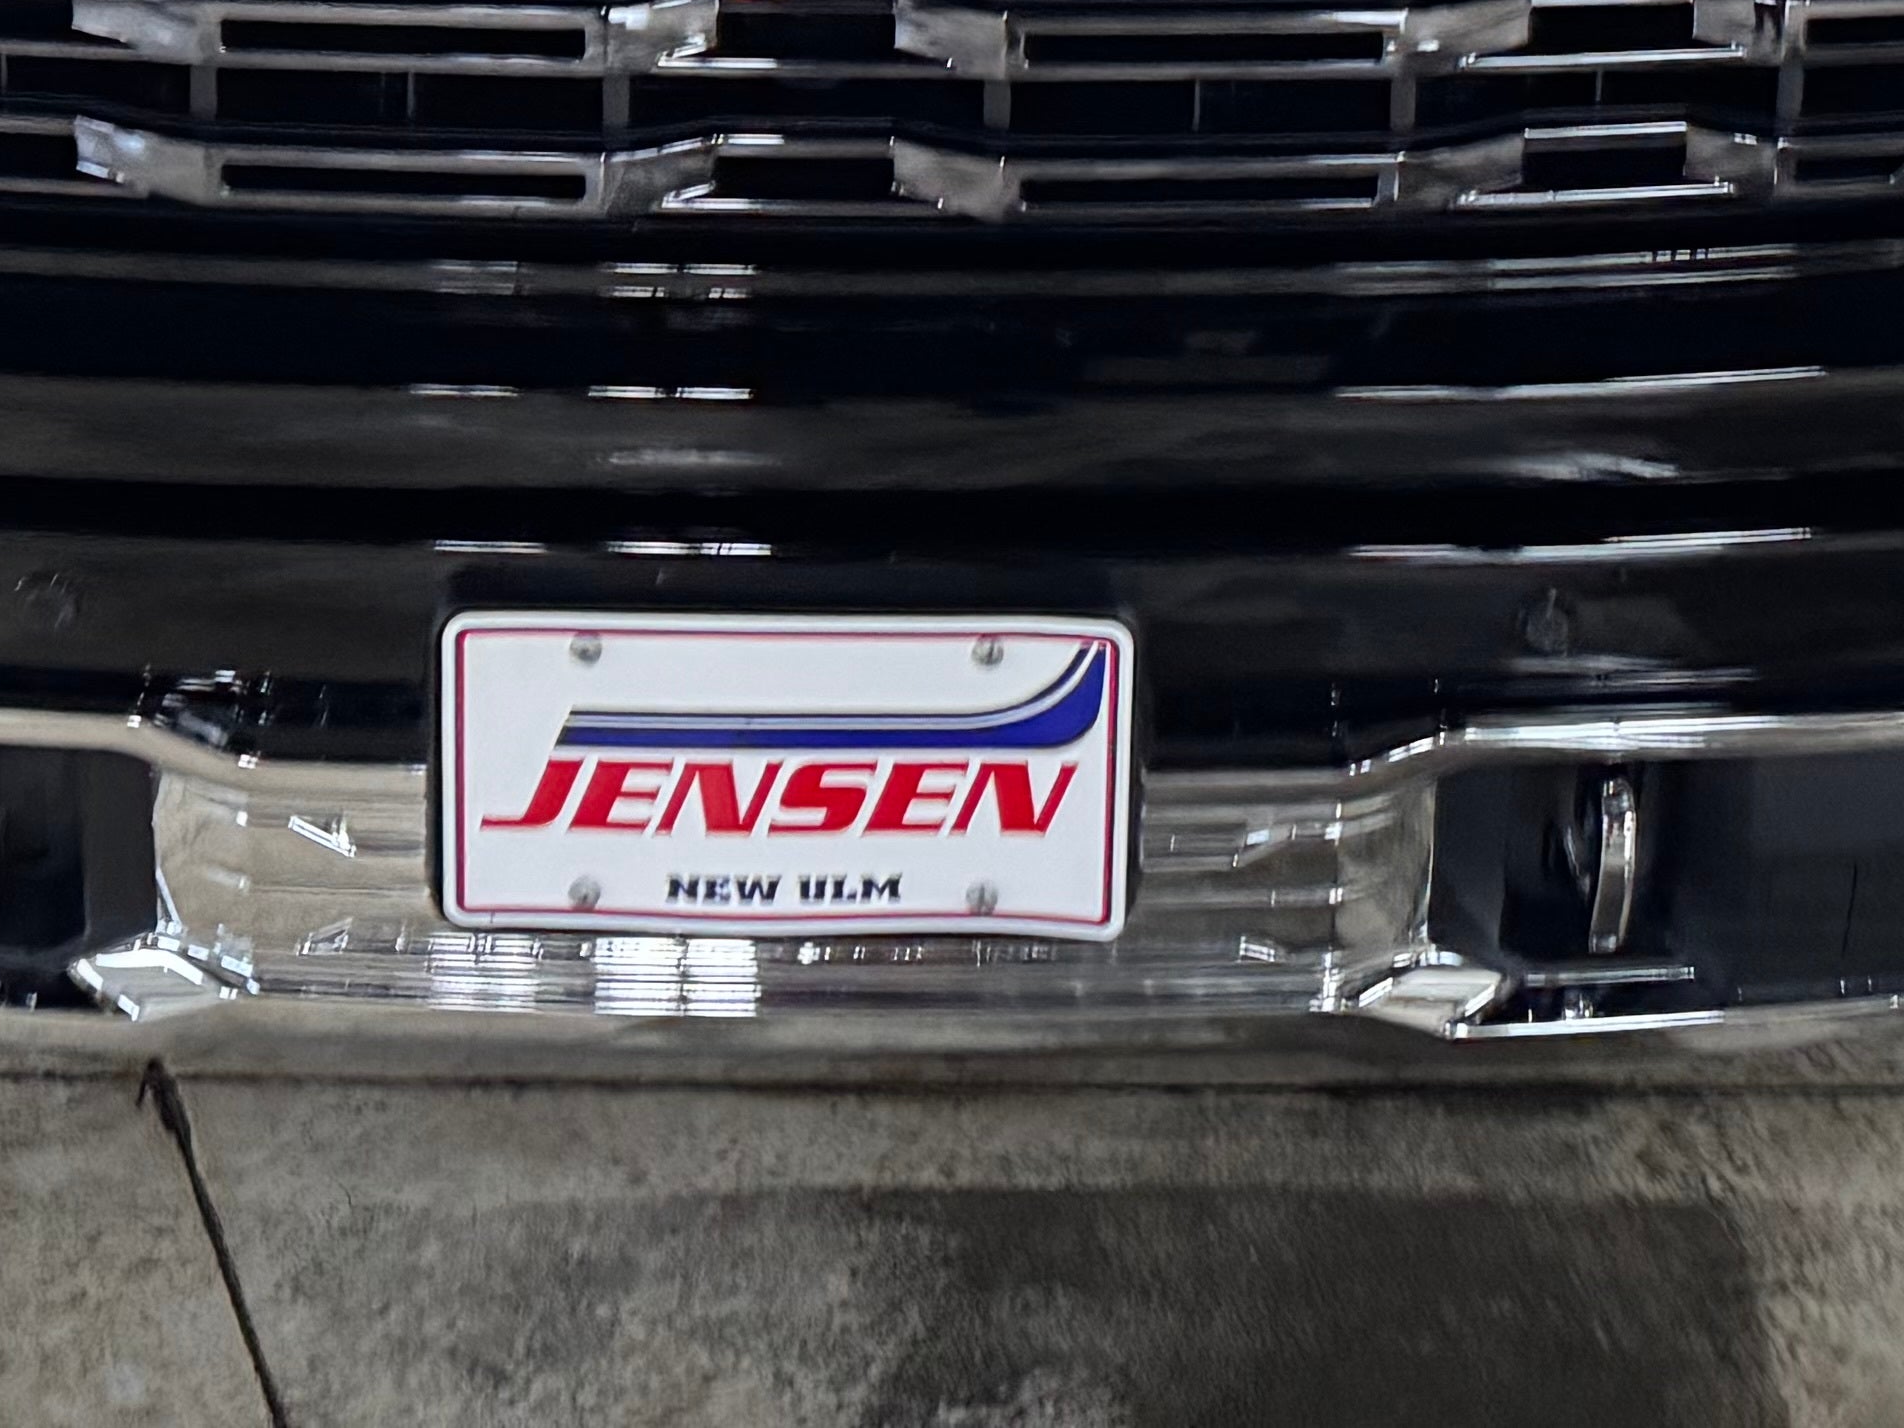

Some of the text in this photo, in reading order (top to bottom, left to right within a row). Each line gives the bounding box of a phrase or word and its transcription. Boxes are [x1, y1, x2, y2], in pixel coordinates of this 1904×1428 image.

[480, 758, 1079, 837] JENSEN
[665, 873, 903, 905] NEW ULM
